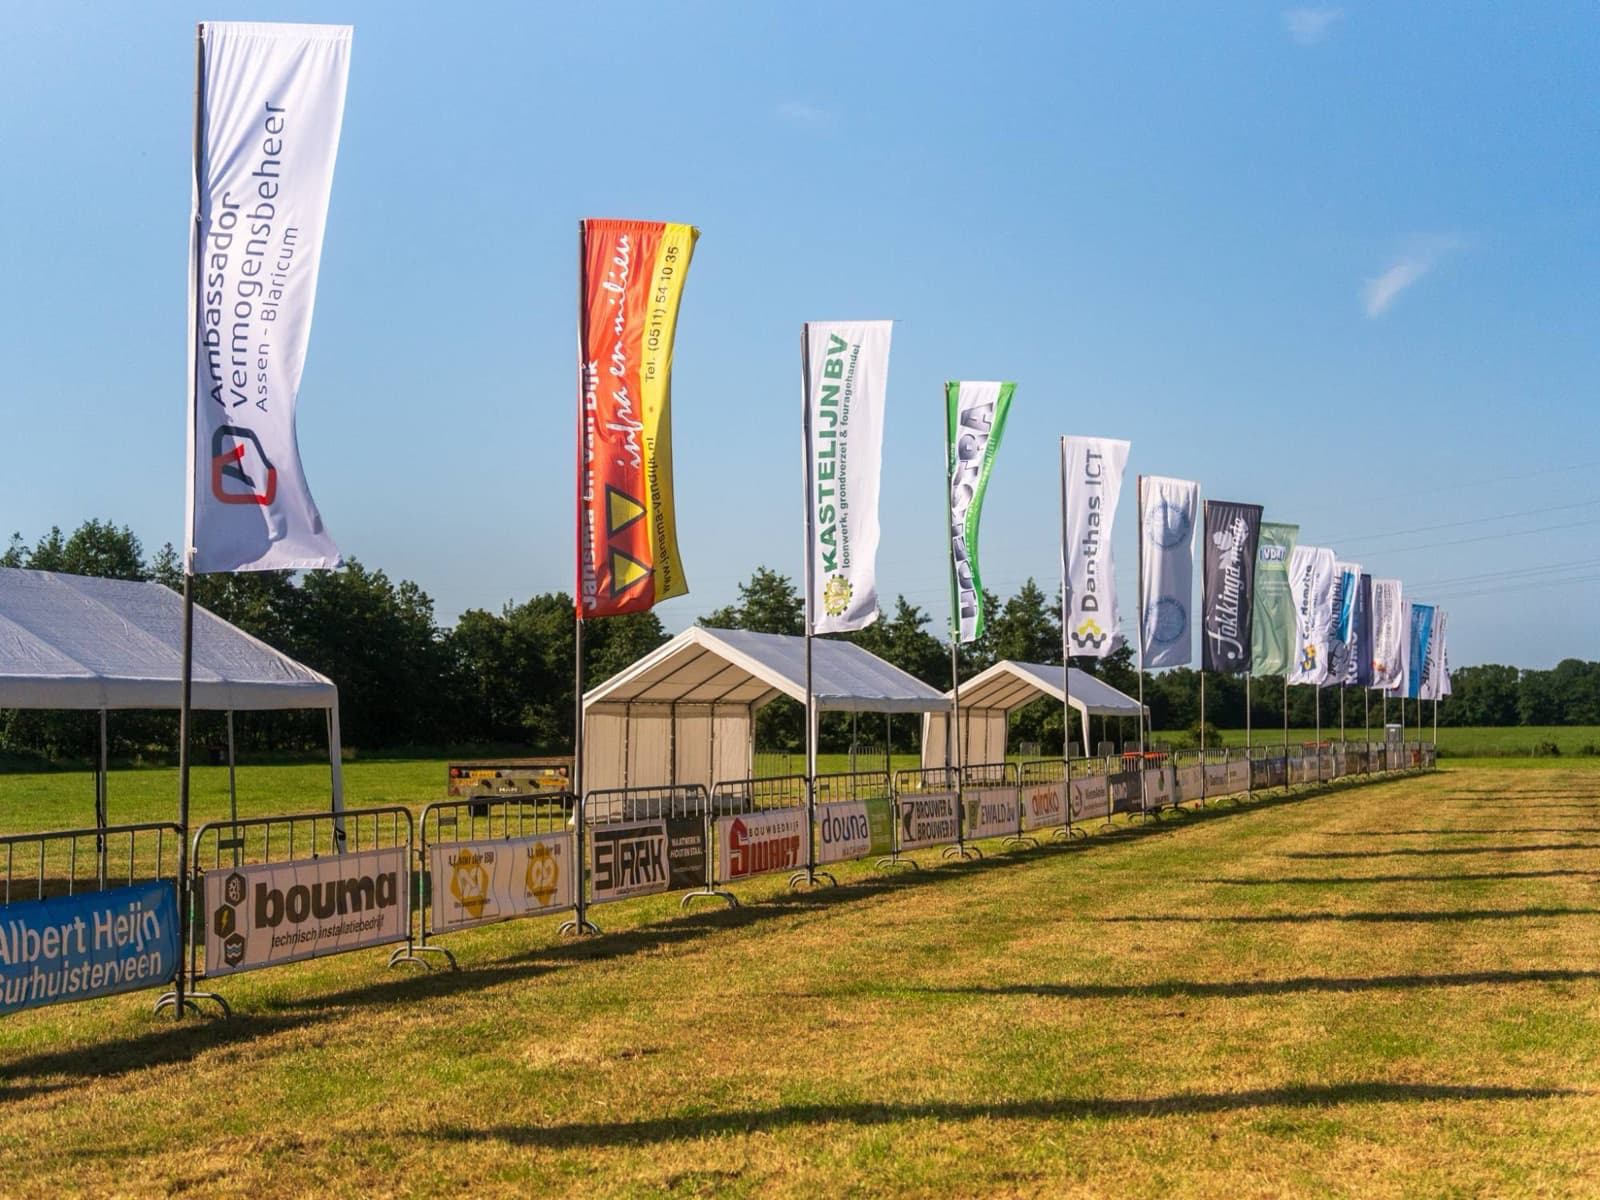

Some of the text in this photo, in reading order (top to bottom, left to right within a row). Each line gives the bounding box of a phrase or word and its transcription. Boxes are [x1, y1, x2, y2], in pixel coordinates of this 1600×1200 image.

[230, 101, 286, 409] Vermogensbeheer
[260, 226, 298, 322] Blaricum
[203, 191, 240, 408] Ambassador
[645, 246, 679, 383] Tel. (0511) 54 10 35
[255, 343, 270, 412] Assen
[582, 359, 599, 412] Dijk
[583, 417, 595, 464] van
[605, 386, 644, 469] infra
[818, 333, 849, 573] KASTELIJN BV
[838, 344, 861, 569] loonwerk, grondverzet & fouragehandel
[1085, 449, 1102, 486] ICT
[645, 436, 671, 594] www.jansma-vandijk.nl
[582, 509, 597, 611] Jansma
[1081, 496, 1100, 612] Danthas
[749, 821, 799, 837] BOUWBEDRIJF
[822, 807, 868, 843] douna
[916, 799, 947, 818] BROUWER
[918, 820, 949, 840] BROUWER
[0, 902, 160, 964] Albert Heijn
[255, 871, 397, 928] bouma
[271, 915, 384, 948] technisch installatiebedrijf
